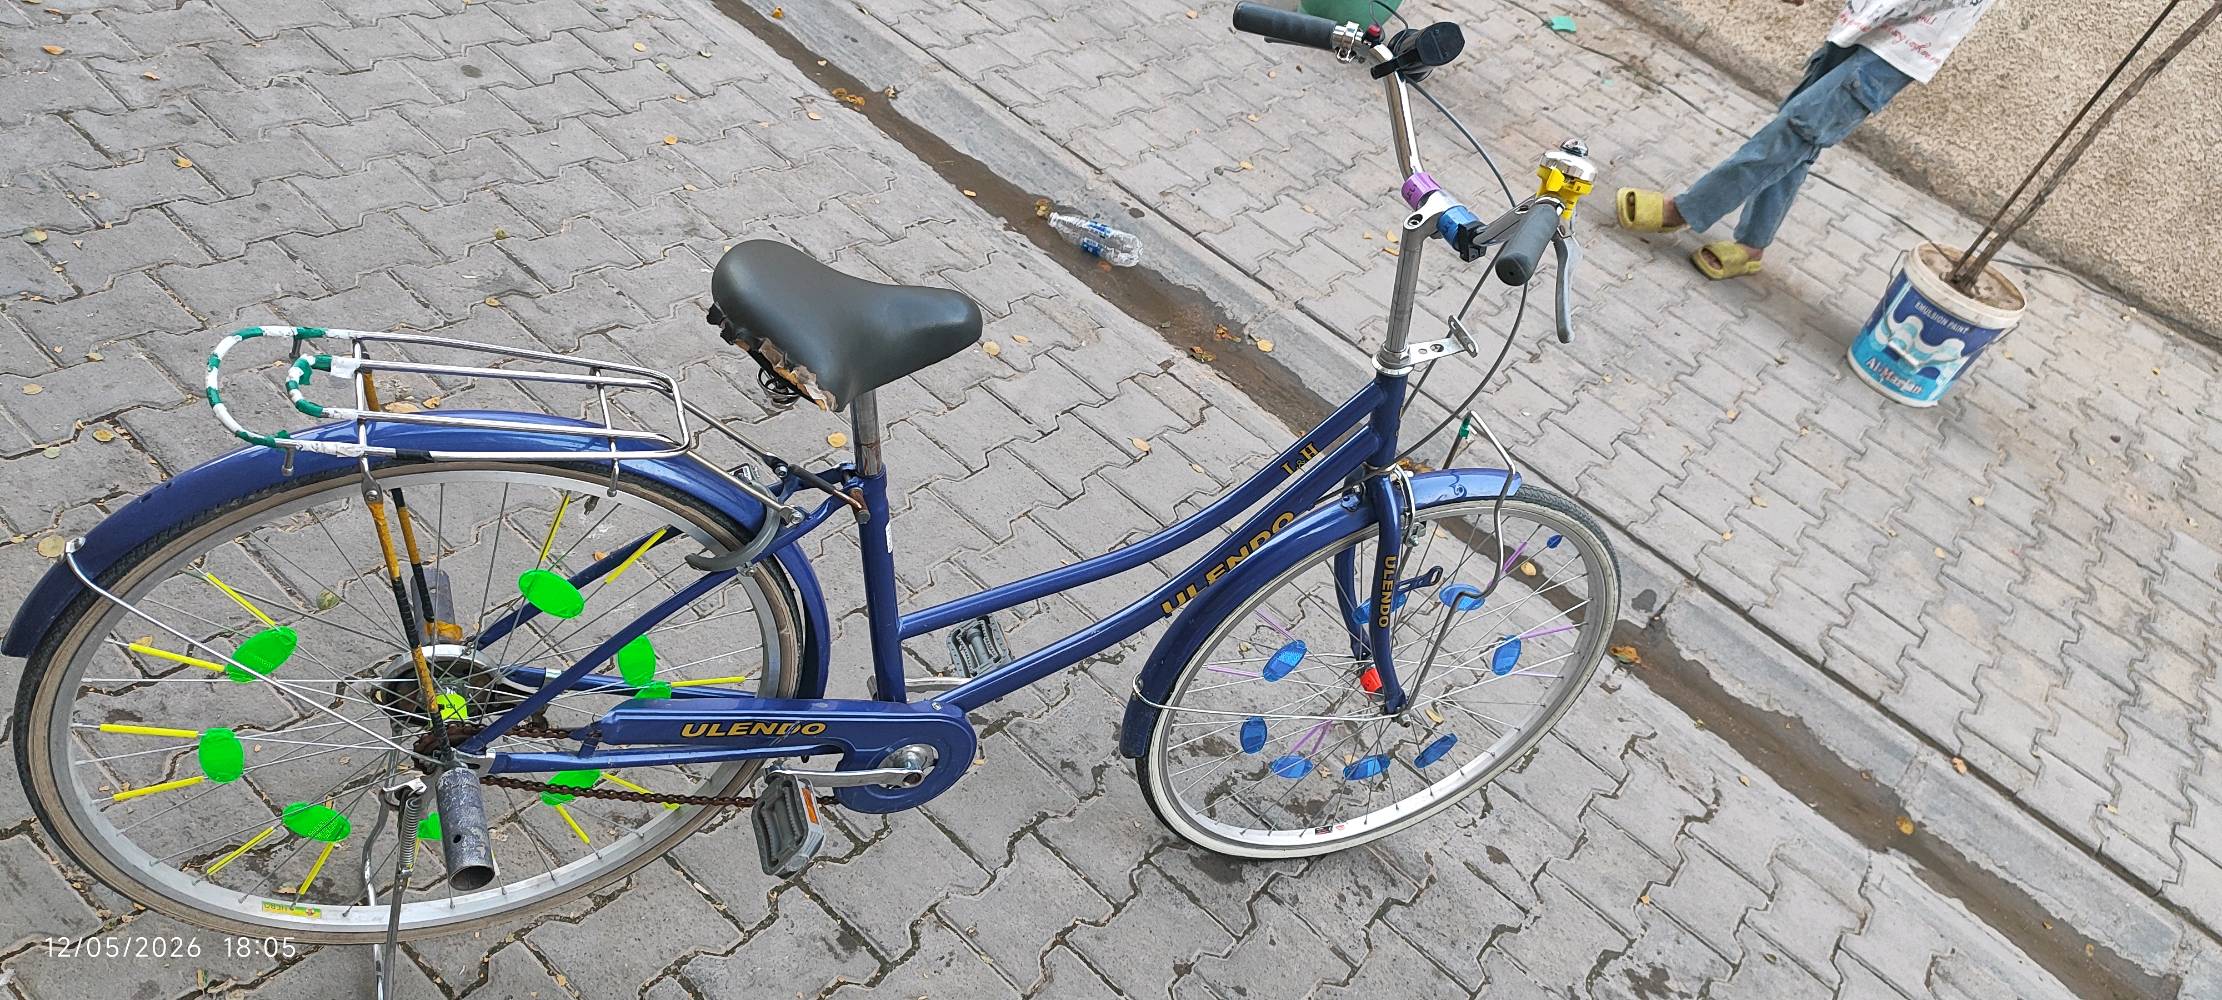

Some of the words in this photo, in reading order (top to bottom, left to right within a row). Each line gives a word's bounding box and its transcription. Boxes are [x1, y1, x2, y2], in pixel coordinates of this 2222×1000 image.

[1914, 302, 1948, 326] EMULSION
[1949, 318, 1969, 334] PAINT
[1379, 556, 1397, 628] ULENDO
[682, 721, 826, 738] ULENDO
